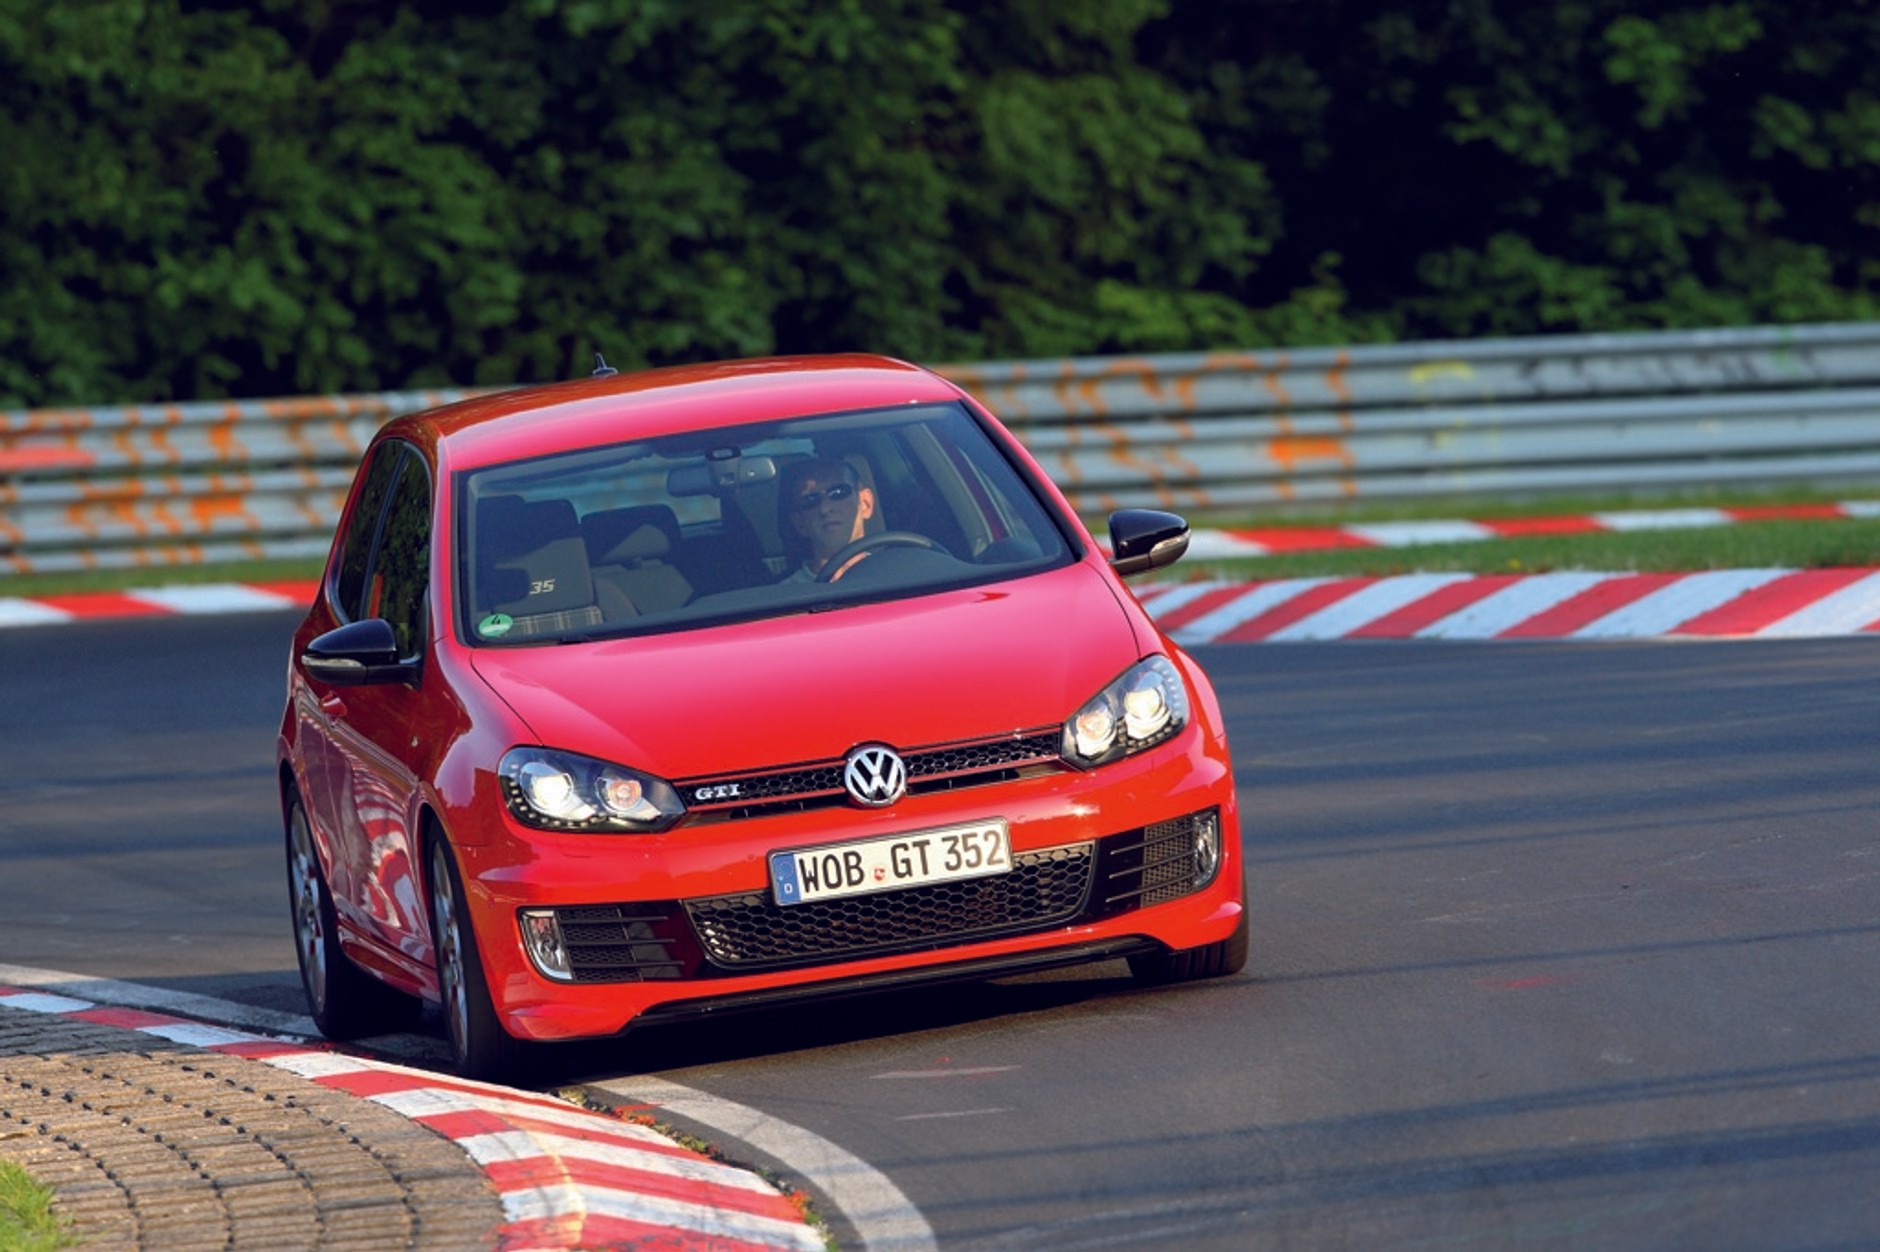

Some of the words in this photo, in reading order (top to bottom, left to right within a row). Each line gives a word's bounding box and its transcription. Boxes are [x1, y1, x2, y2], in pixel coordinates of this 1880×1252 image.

[529, 578, 556, 595] 35
[695, 783, 741, 800] GTI
[799, 851, 865, 893] WOB
[890, 839, 931, 879] GT
[941, 829, 1005, 872] 352
